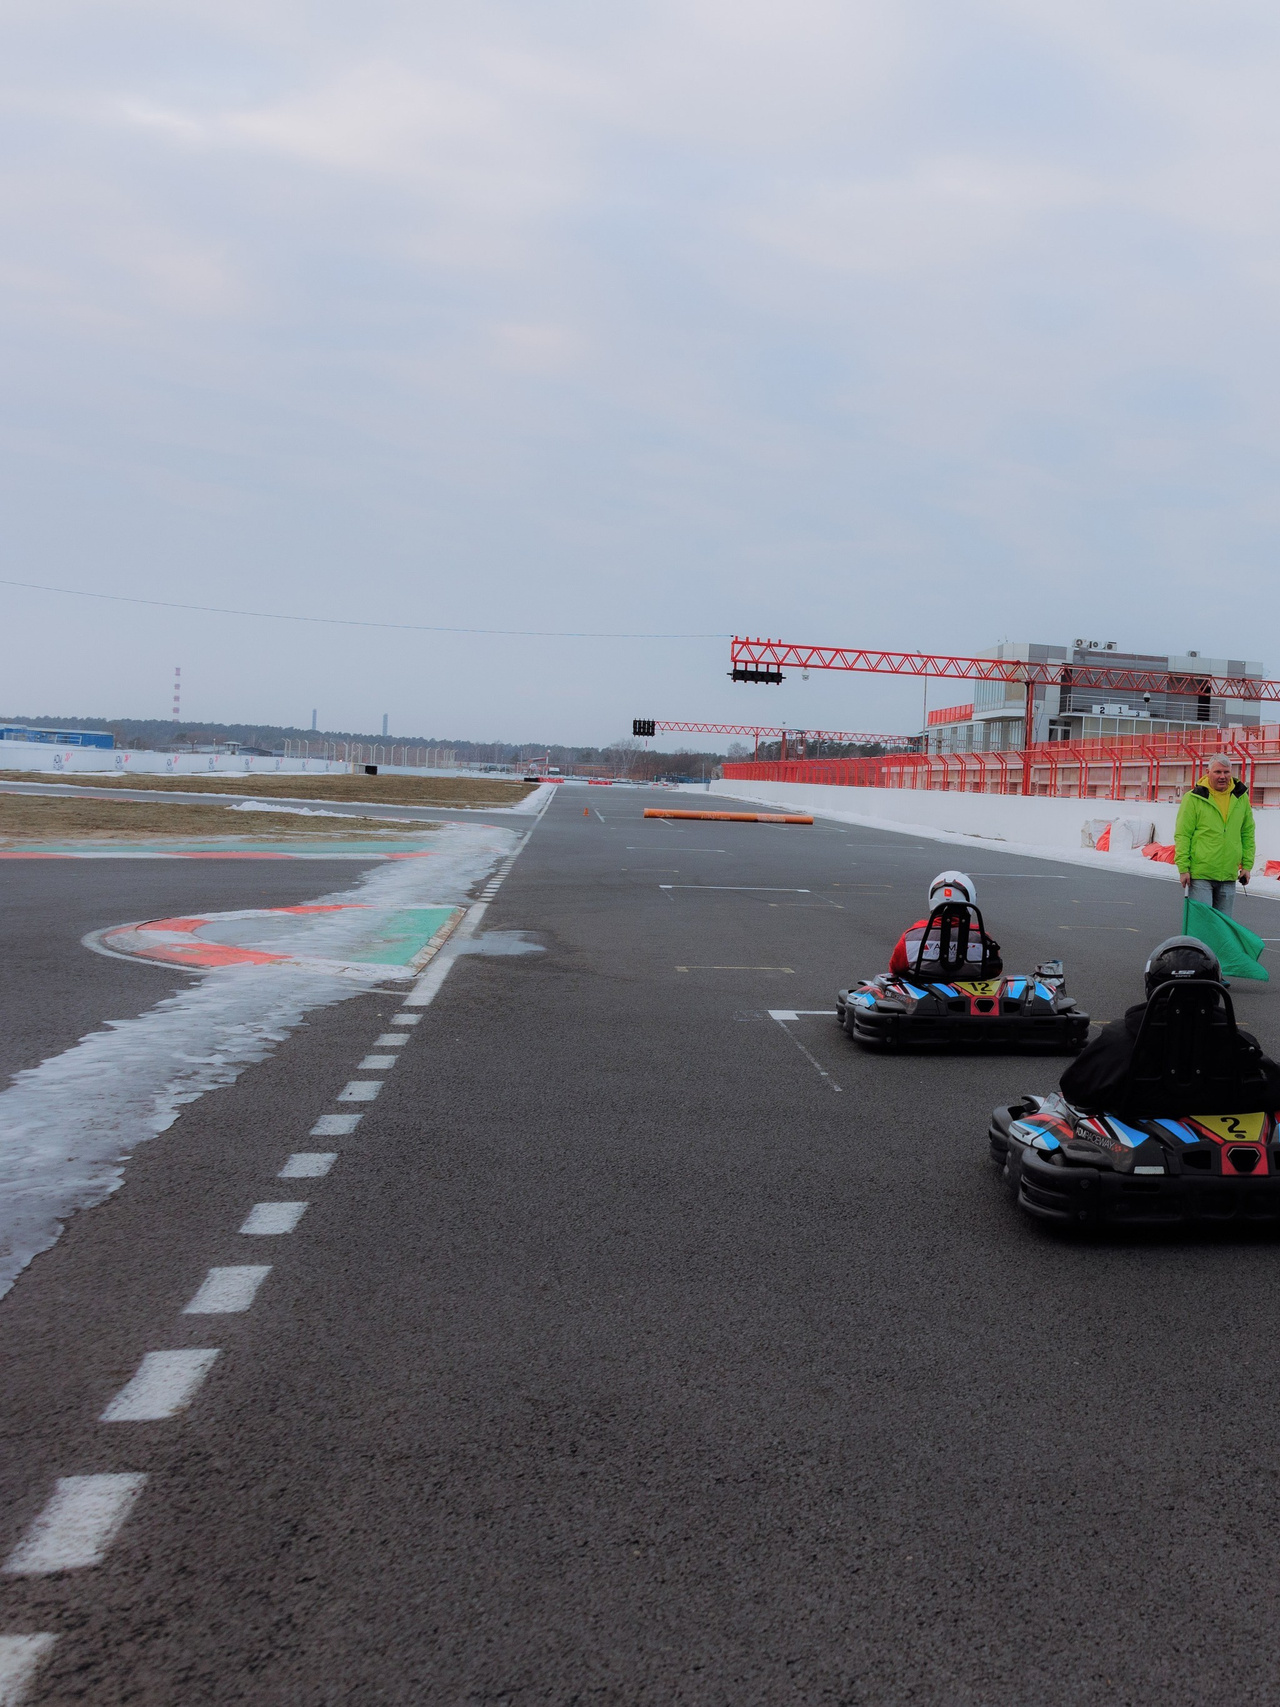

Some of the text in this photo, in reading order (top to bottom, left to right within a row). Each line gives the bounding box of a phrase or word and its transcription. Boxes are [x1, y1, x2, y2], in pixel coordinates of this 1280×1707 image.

[1099, 706, 1106, 715] 2
[1118, 706, 1123, 715] 1
[934, 942, 957, 952] AM
[967, 982, 993, 993] 12
[1220, 1117, 1247, 1134] 2
